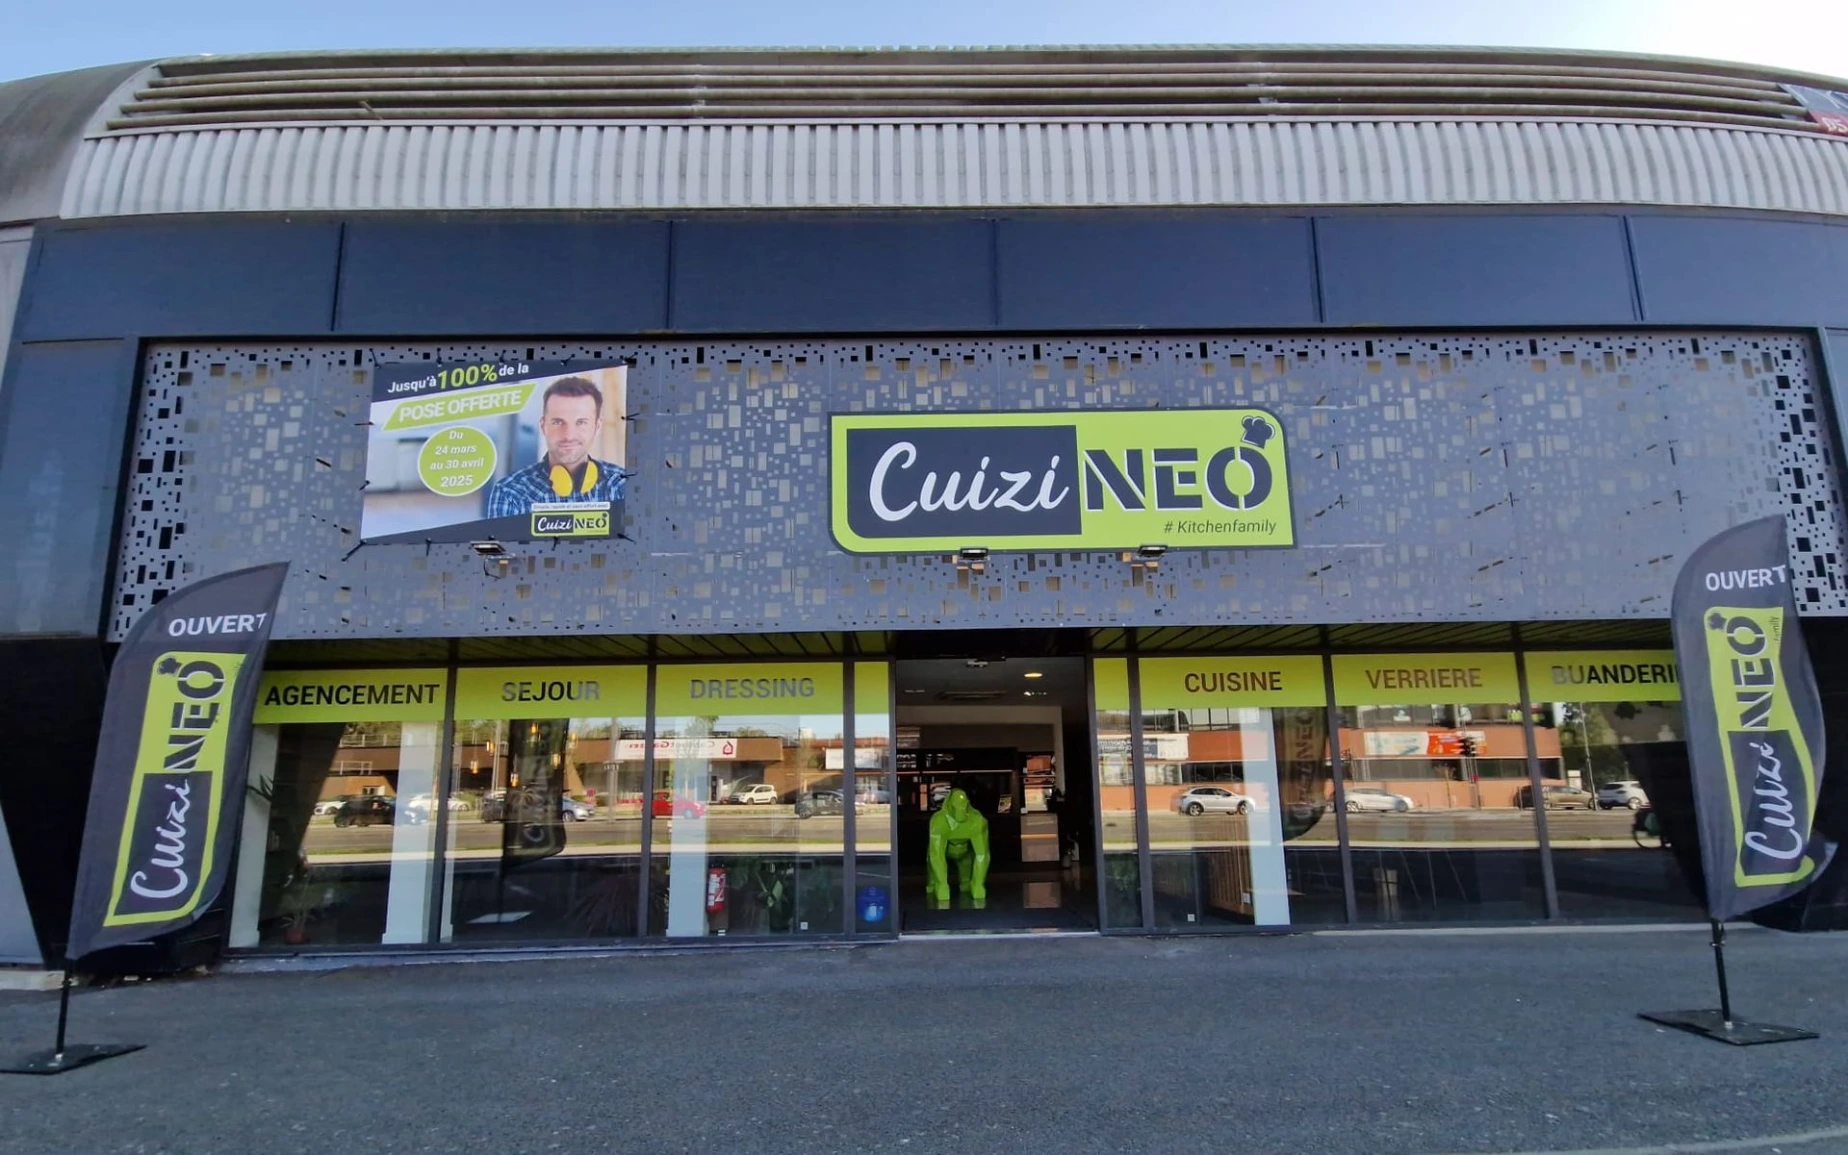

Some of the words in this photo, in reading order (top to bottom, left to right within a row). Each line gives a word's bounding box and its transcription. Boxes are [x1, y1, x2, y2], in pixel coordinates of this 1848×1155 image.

[388, 375, 437, 393] Jusqu'à
[438, 364, 498, 389] 100%
[499, 365, 514, 376] de
[518, 363, 529, 374] la
[400, 401, 445, 422] POSE
[448, 390, 522, 414] OFFERTE
[449, 431, 463, 439] Du
[435, 446, 448, 455] 24
[451, 445, 477, 454] mars
[430, 462, 443, 470] au
[445, 459, 459, 469] 30
[461, 458, 484, 468] avril
[441, 475, 473, 487] 2025
[1177, 519, 1276, 535] Kitchenfamily
[1705, 564, 1786, 591] OUVERT
[168, 612, 267, 636] OUVERT
[1185, 671, 1283, 693] CUISINE
[1365, 668, 1483, 689] VERRIERE
[1552, 664, 1680, 685] BUANDERI
[264, 684, 440, 706] AGENCEMENT
[501, 681, 600, 701] SEJOUR
[690, 678, 815, 699] DRESSING
